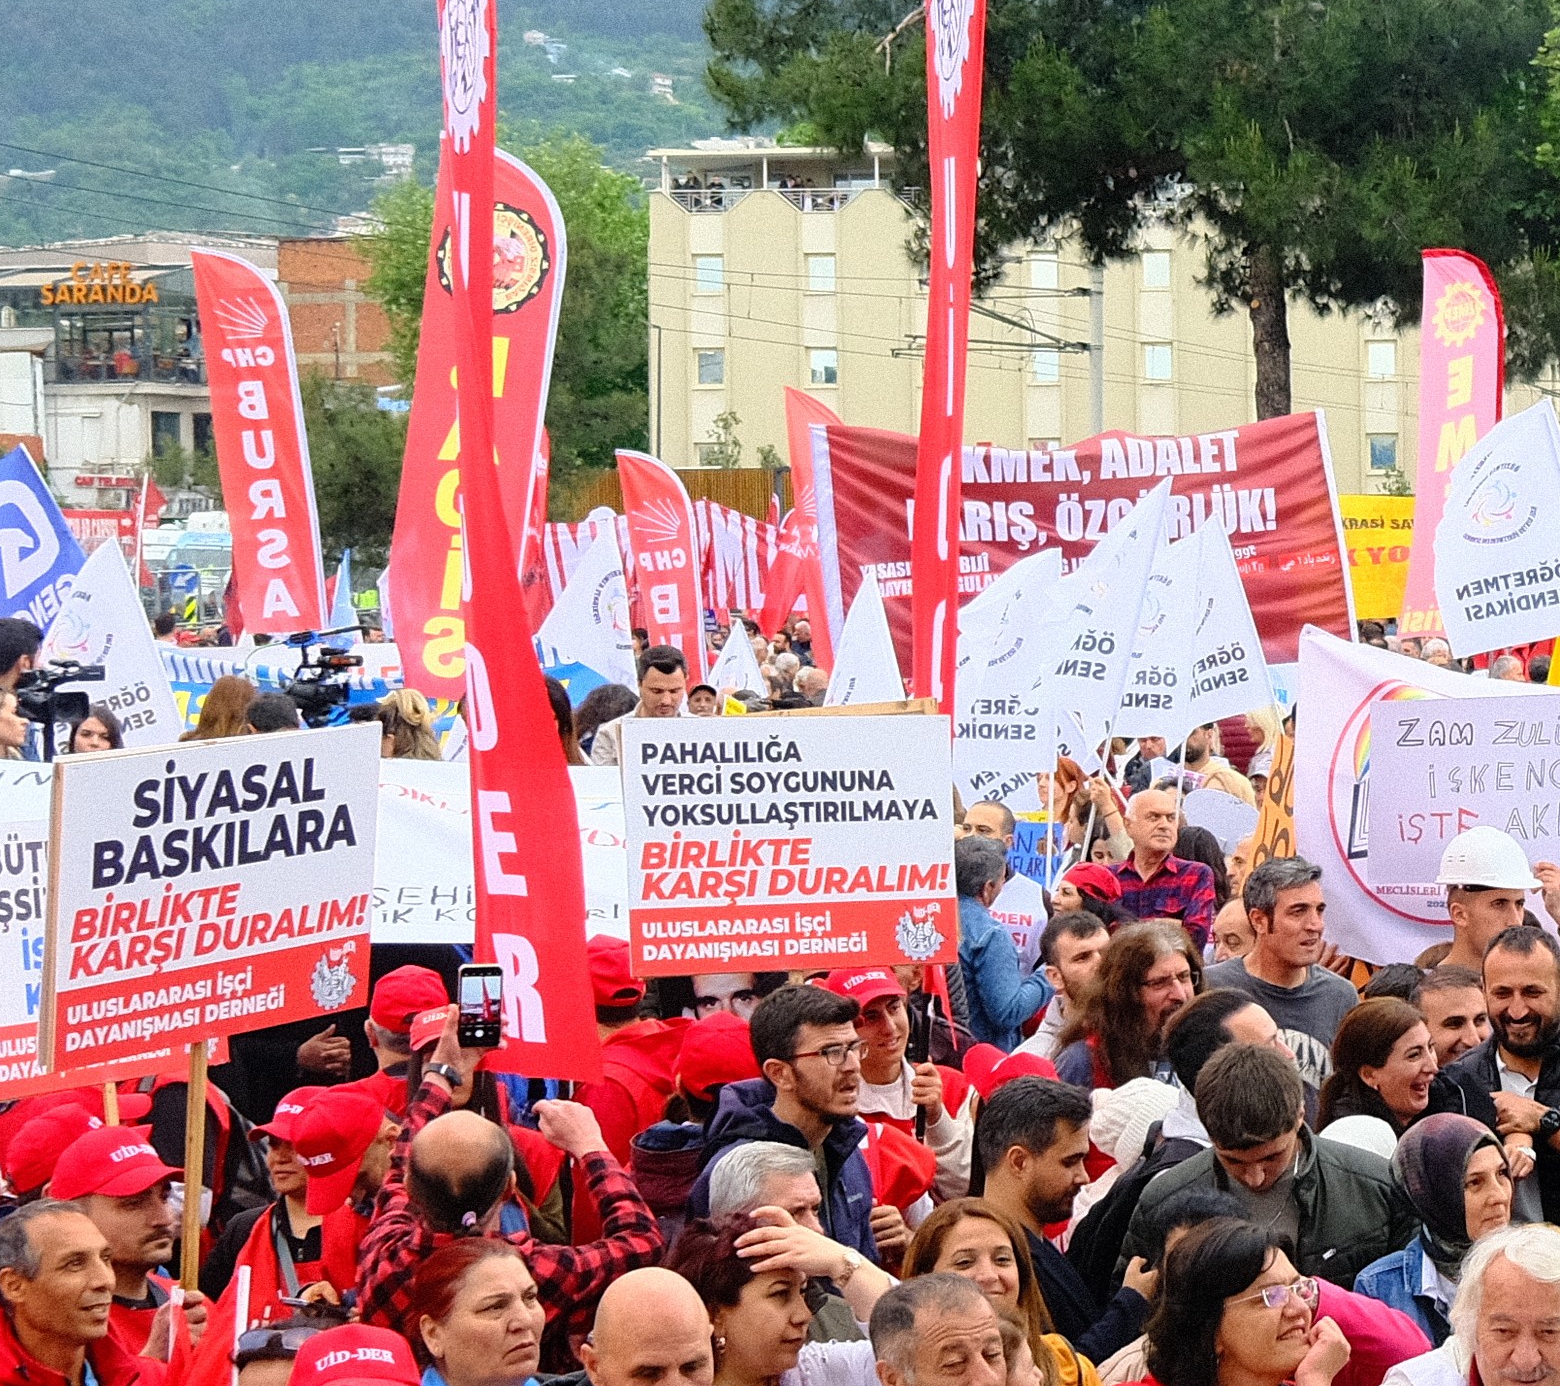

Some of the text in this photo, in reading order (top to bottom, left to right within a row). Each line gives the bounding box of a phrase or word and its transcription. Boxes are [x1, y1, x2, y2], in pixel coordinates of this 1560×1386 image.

[70, 261, 132, 283] CAFE
[41, 282, 159, 305] SARANDA
[960, 431, 1239, 486] KMEK, ADALET
[642, 733, 802, 765] PAHALILIĞA
[1396, 717, 1474, 747] ZAM
[133, 756, 326, 829] SİYASAL
[642, 767, 895, 798] VERGİ SOYGUNUNA
[642, 798, 939, 829] YOKSULLAŞTIRILMAYA
[92, 802, 357, 889] BASKILARA
[642, 831, 813, 869] BİRLİKTE
[641, 863, 950, 906] KARŞI DURALIM!
[70, 882, 241, 944] BİRLİKTE
[642, 911, 833, 943] ULUSLARARASI İŞÇİ
[69, 927, 189, 981] KARŞI
[194, 893, 369, 956] DURALIM!
[642, 930, 868, 965] DAYANIŞMASI DERNEĞİ
[66, 969, 253, 1025] ULUSLARARASI İŞÇİ
[65, 985, 286, 1053] DAYANIŞMASI DERNEĞİ
[314, 1346, 395, 1374] UİD-DER
